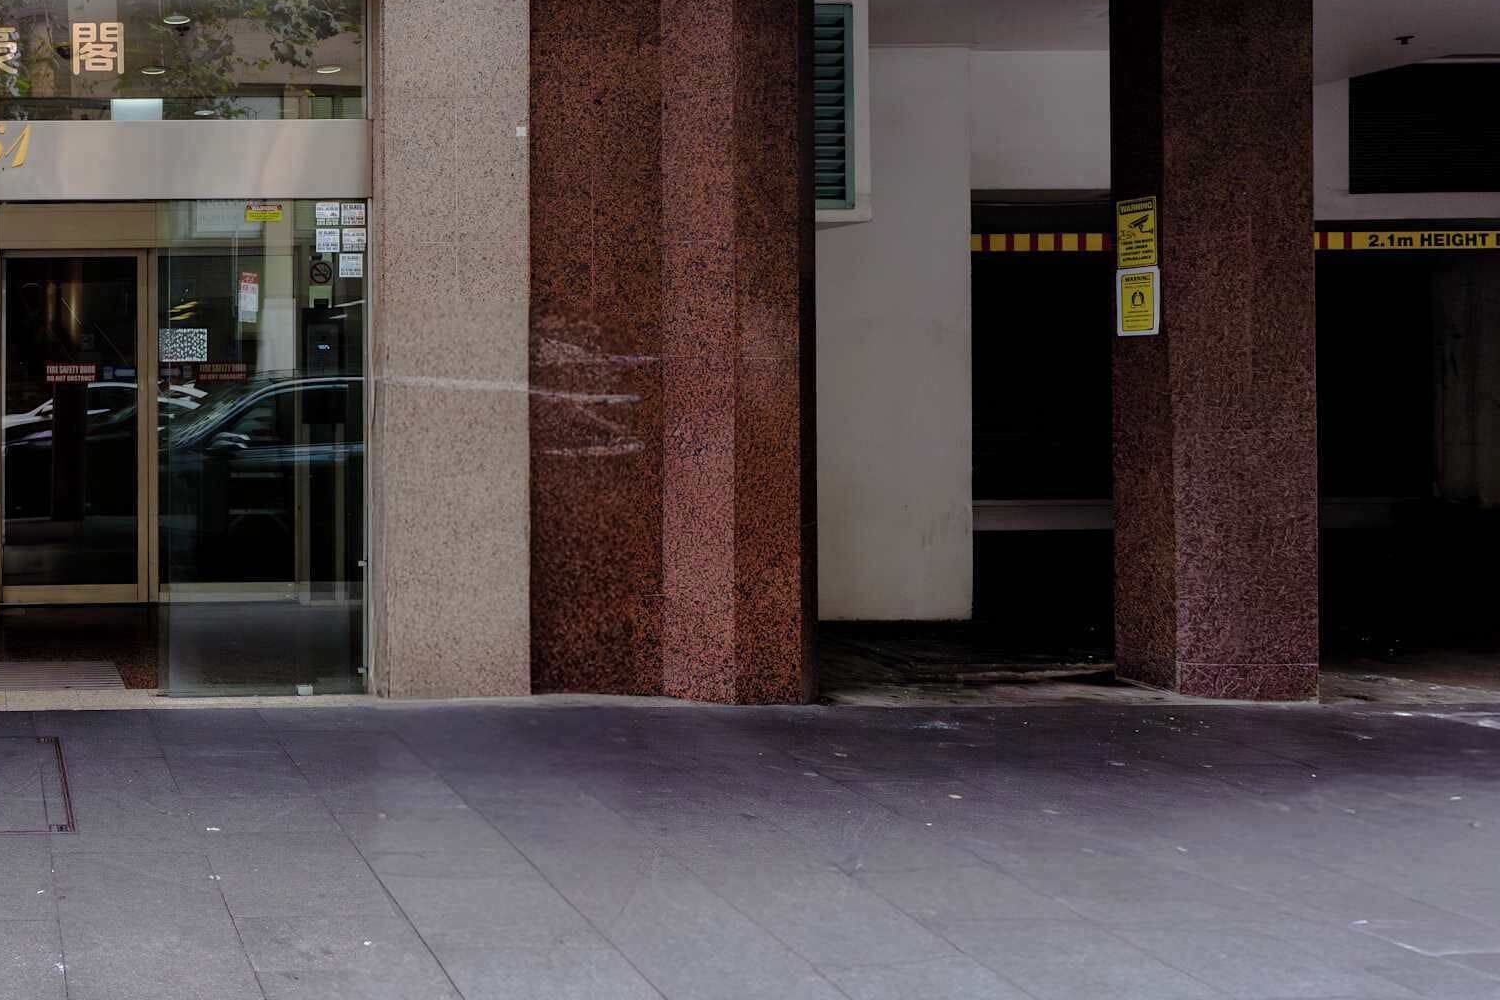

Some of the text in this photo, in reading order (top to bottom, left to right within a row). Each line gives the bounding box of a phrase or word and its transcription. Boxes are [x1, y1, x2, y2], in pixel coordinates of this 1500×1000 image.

[1120, 201, 1153, 214] WARNING
[1368, 234, 1413, 247] 2.1m
[1420, 232, 1489, 247] HEIGHT
[46, 365, 58, 374] FIRE
[59, 365, 79, 374] SAFETY
